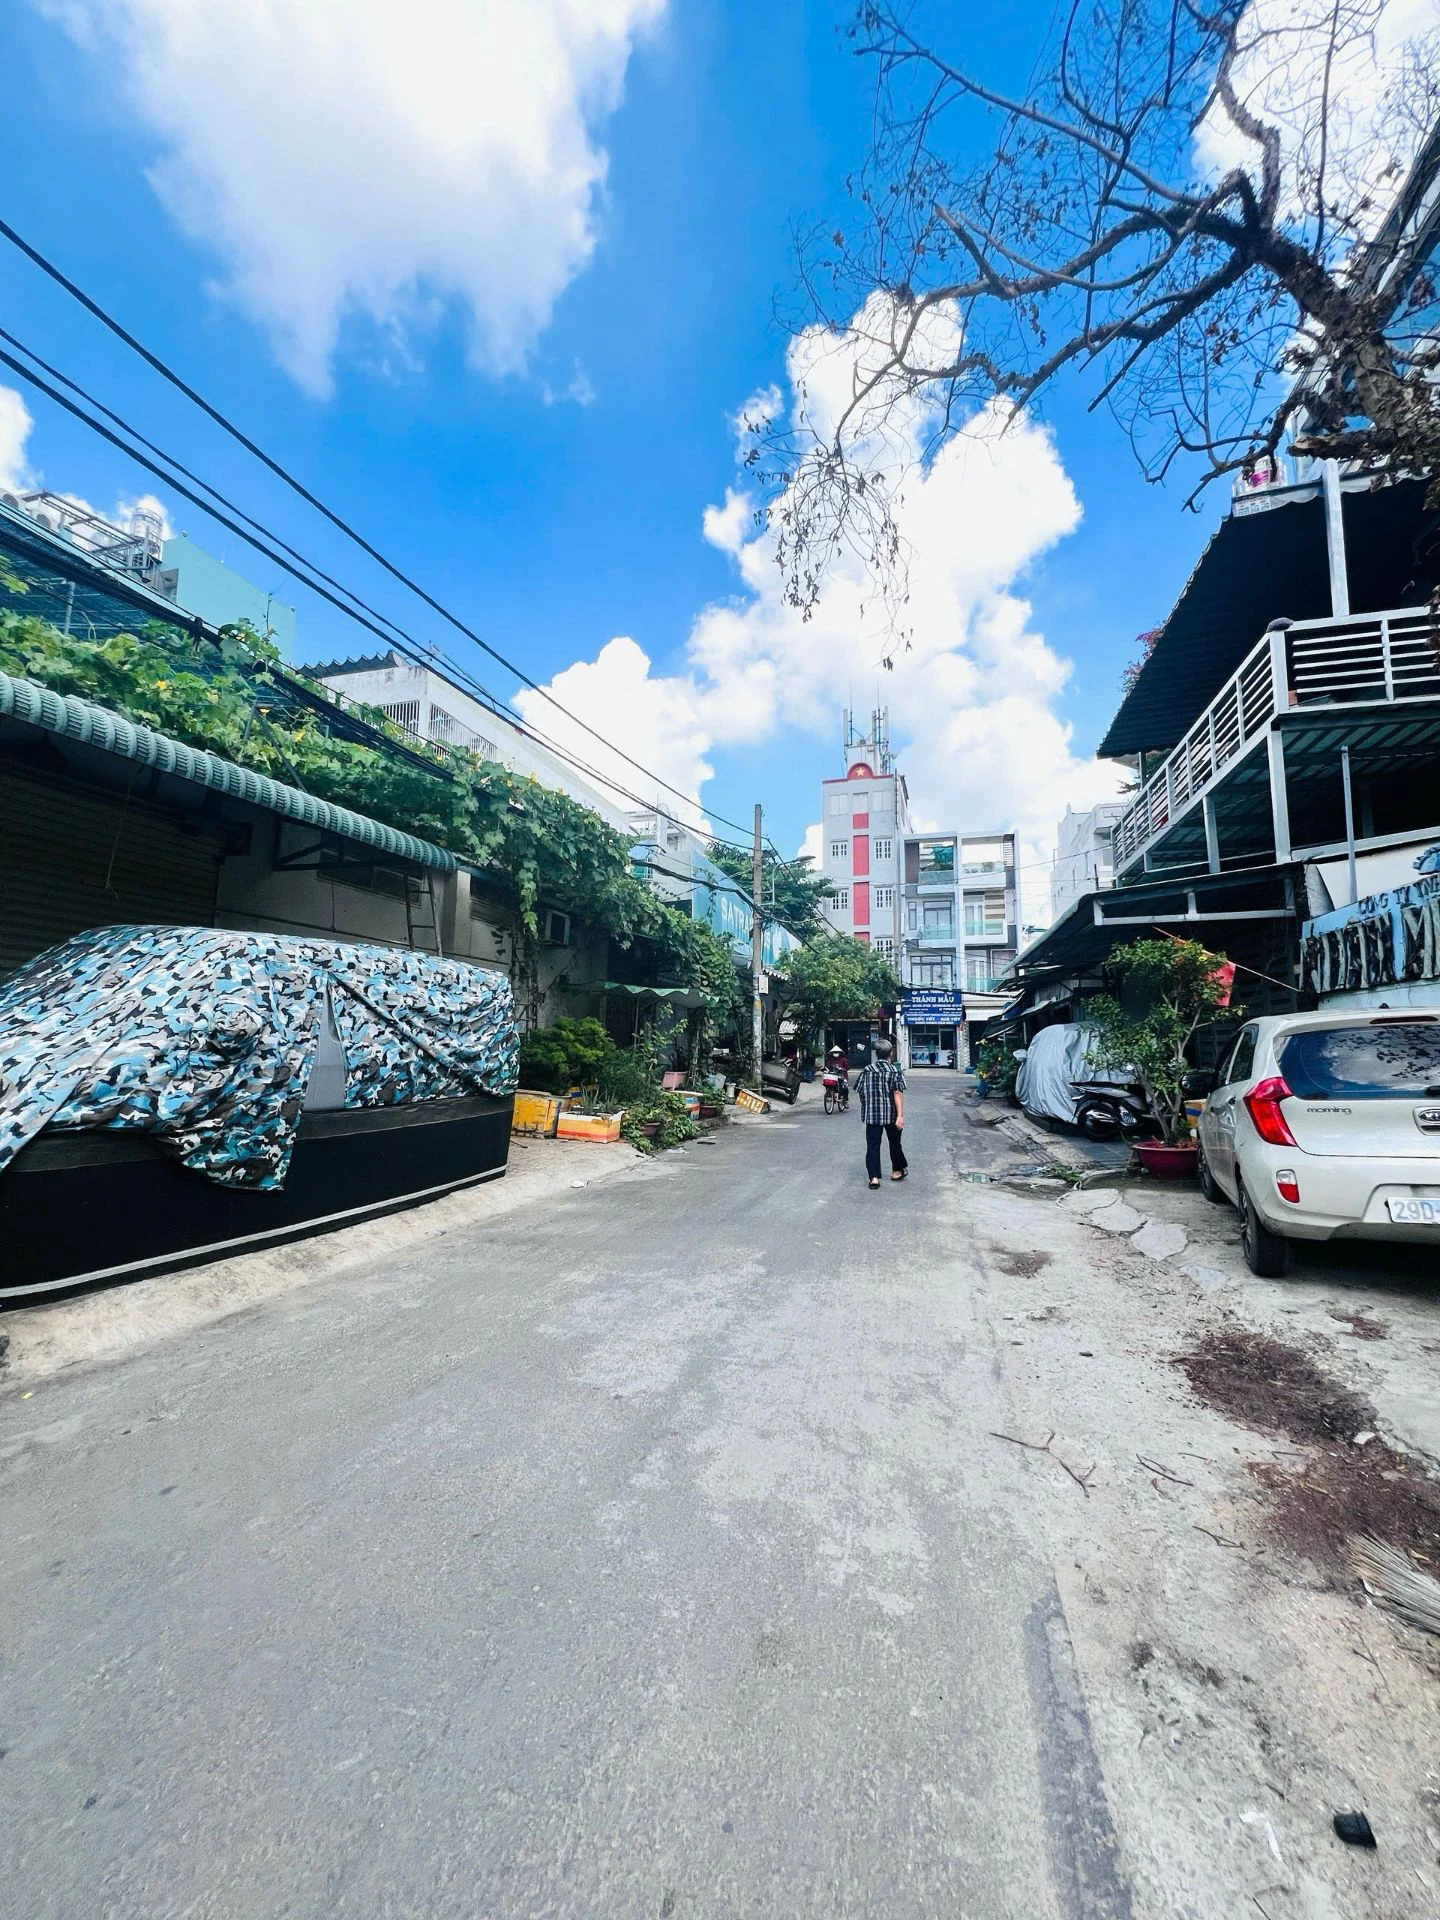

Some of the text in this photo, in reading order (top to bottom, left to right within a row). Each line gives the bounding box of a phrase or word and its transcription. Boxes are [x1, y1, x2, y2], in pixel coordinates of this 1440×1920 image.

[1392, 886, 1411, 905] TY
[911, 995, 937, 1003] THÁNH
[1306, 1106, 1352, 1115] morning
